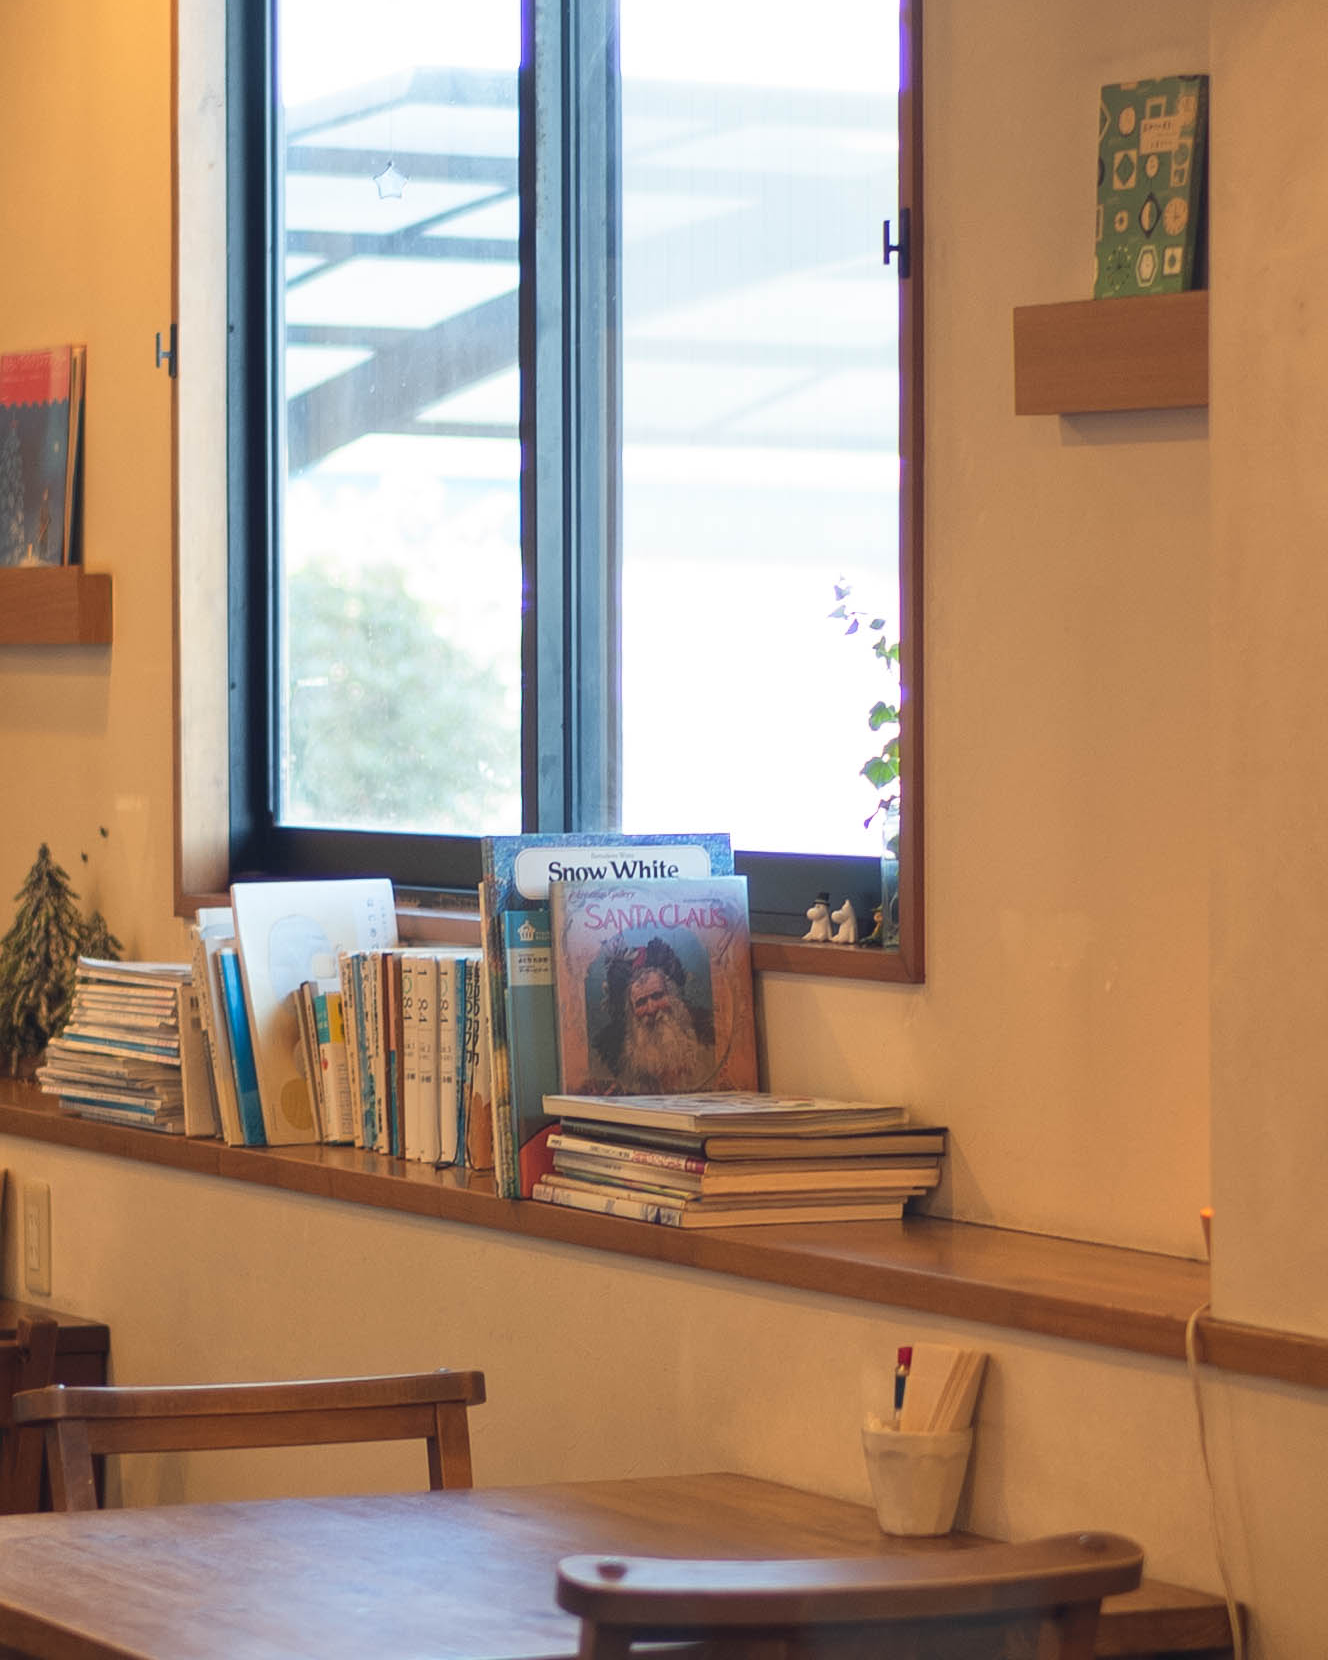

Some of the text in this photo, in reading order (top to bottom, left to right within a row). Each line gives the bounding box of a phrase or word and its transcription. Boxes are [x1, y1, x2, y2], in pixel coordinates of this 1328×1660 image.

[548, 859, 679, 883] Snow White
[583, 903, 729, 932] SANTA CLAUS
